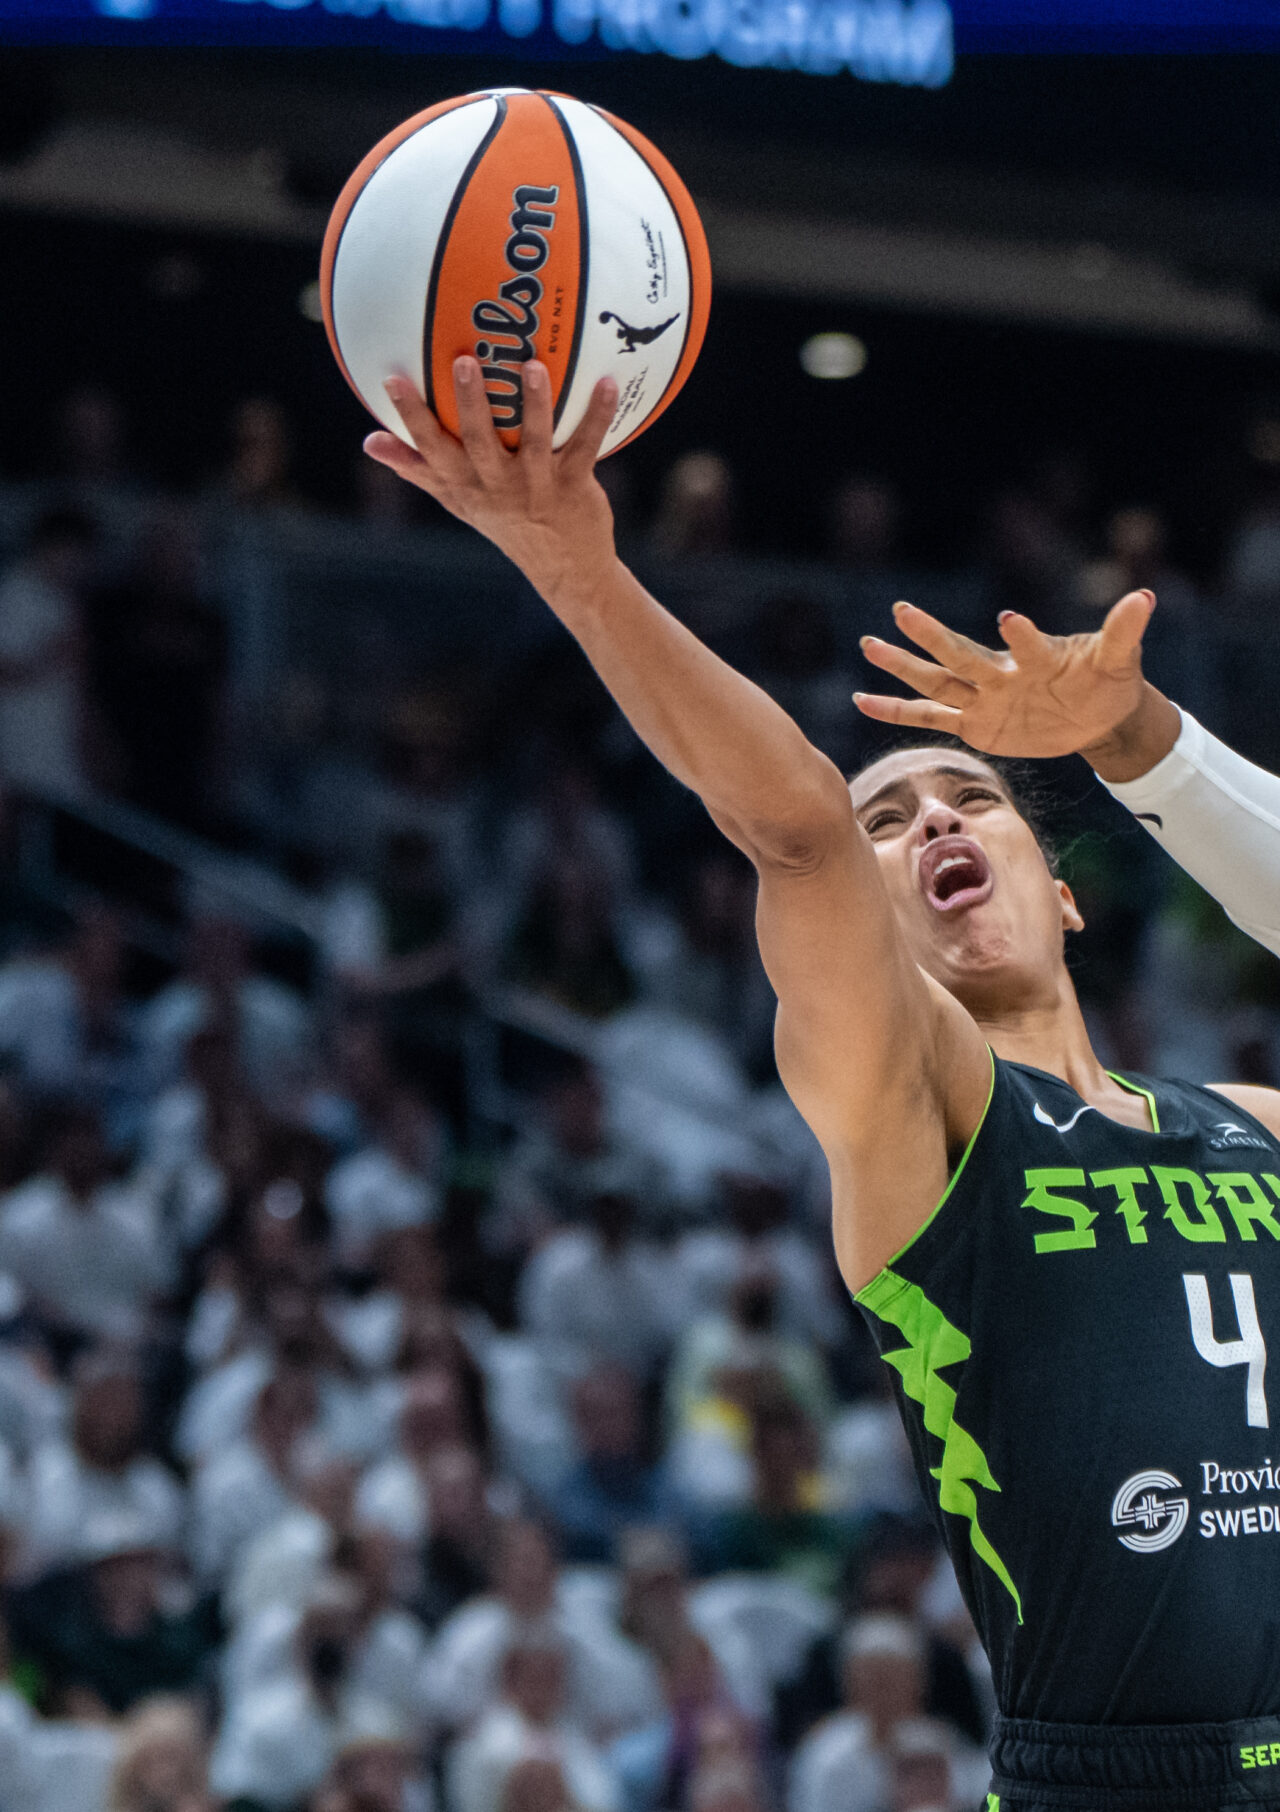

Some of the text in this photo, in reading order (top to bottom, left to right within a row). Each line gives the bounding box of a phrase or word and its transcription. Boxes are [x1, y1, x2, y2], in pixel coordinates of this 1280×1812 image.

[471, 184, 560, 429] Wilson
[548, 285, 564, 353] EVO NXT
[1182, 1273, 1269, 1429] 4
